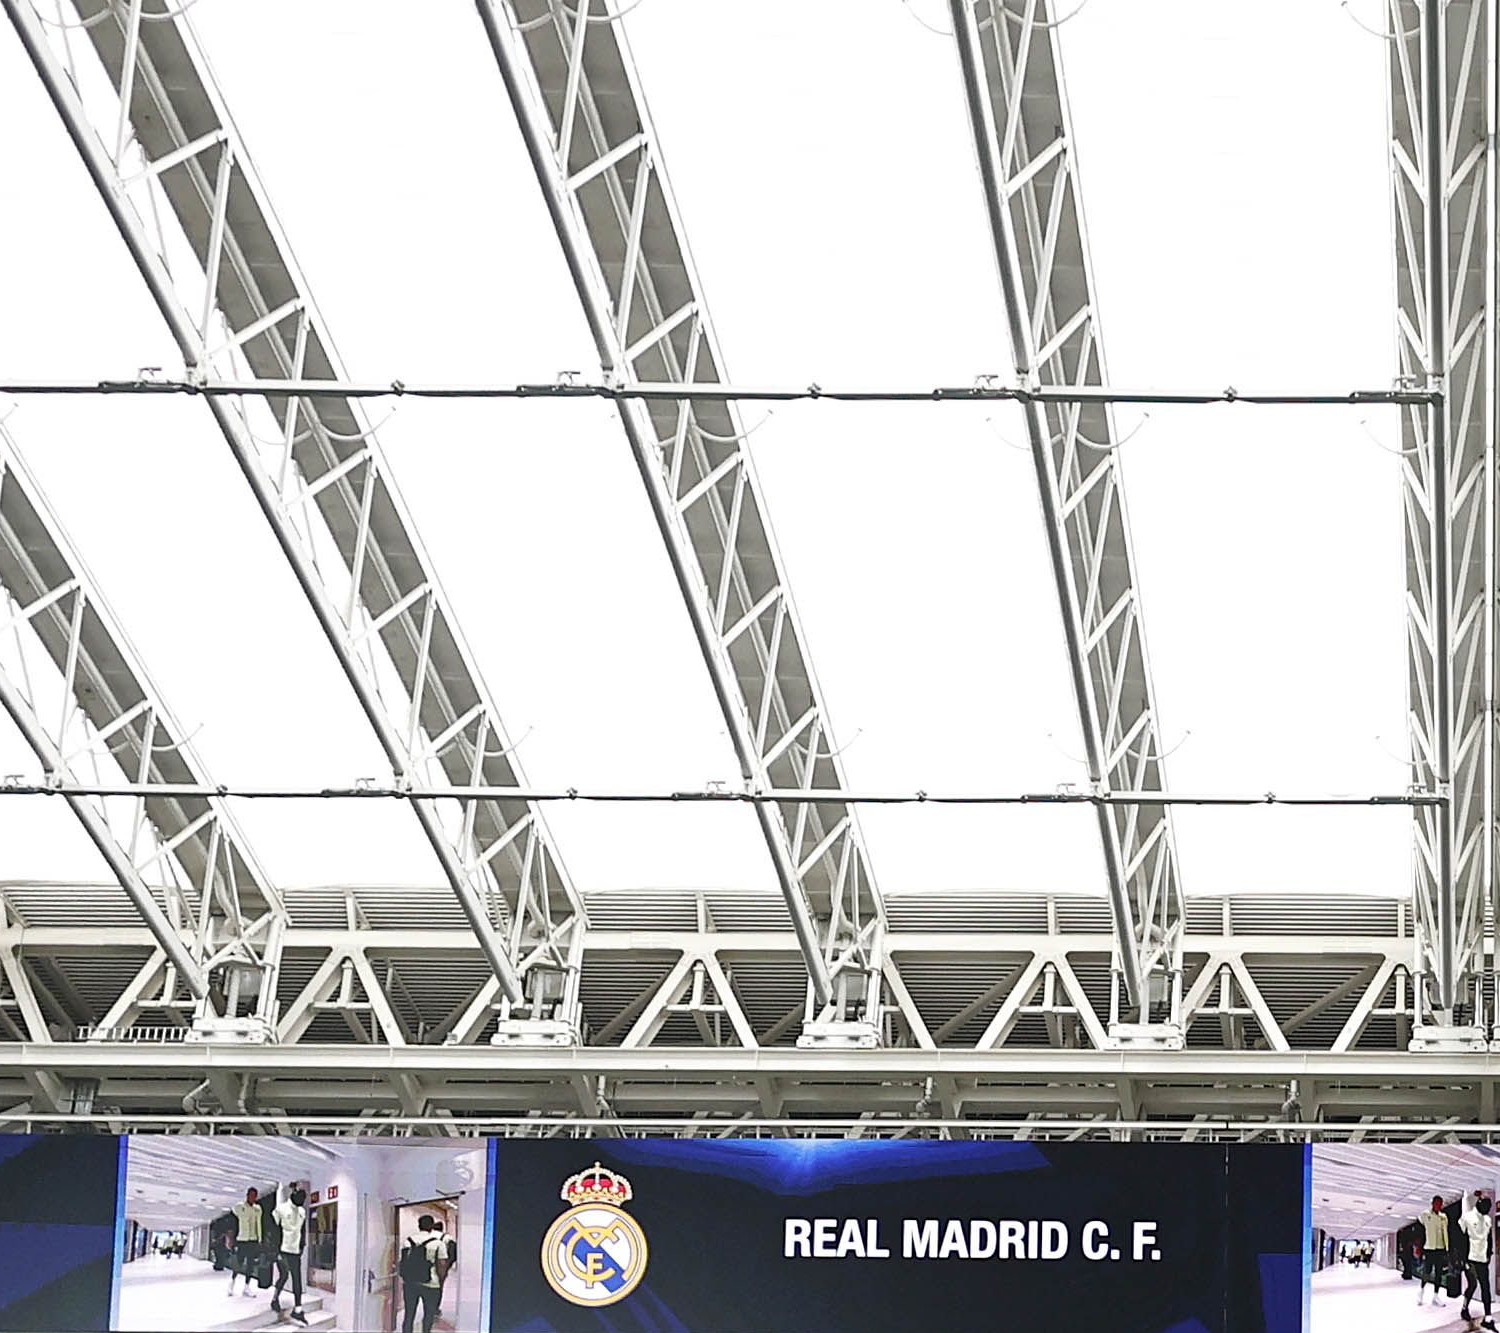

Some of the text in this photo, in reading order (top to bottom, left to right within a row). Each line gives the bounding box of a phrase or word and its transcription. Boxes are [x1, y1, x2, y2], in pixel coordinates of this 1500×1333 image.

[783, 1218, 1163, 1261] REAL MADRID C. F.
